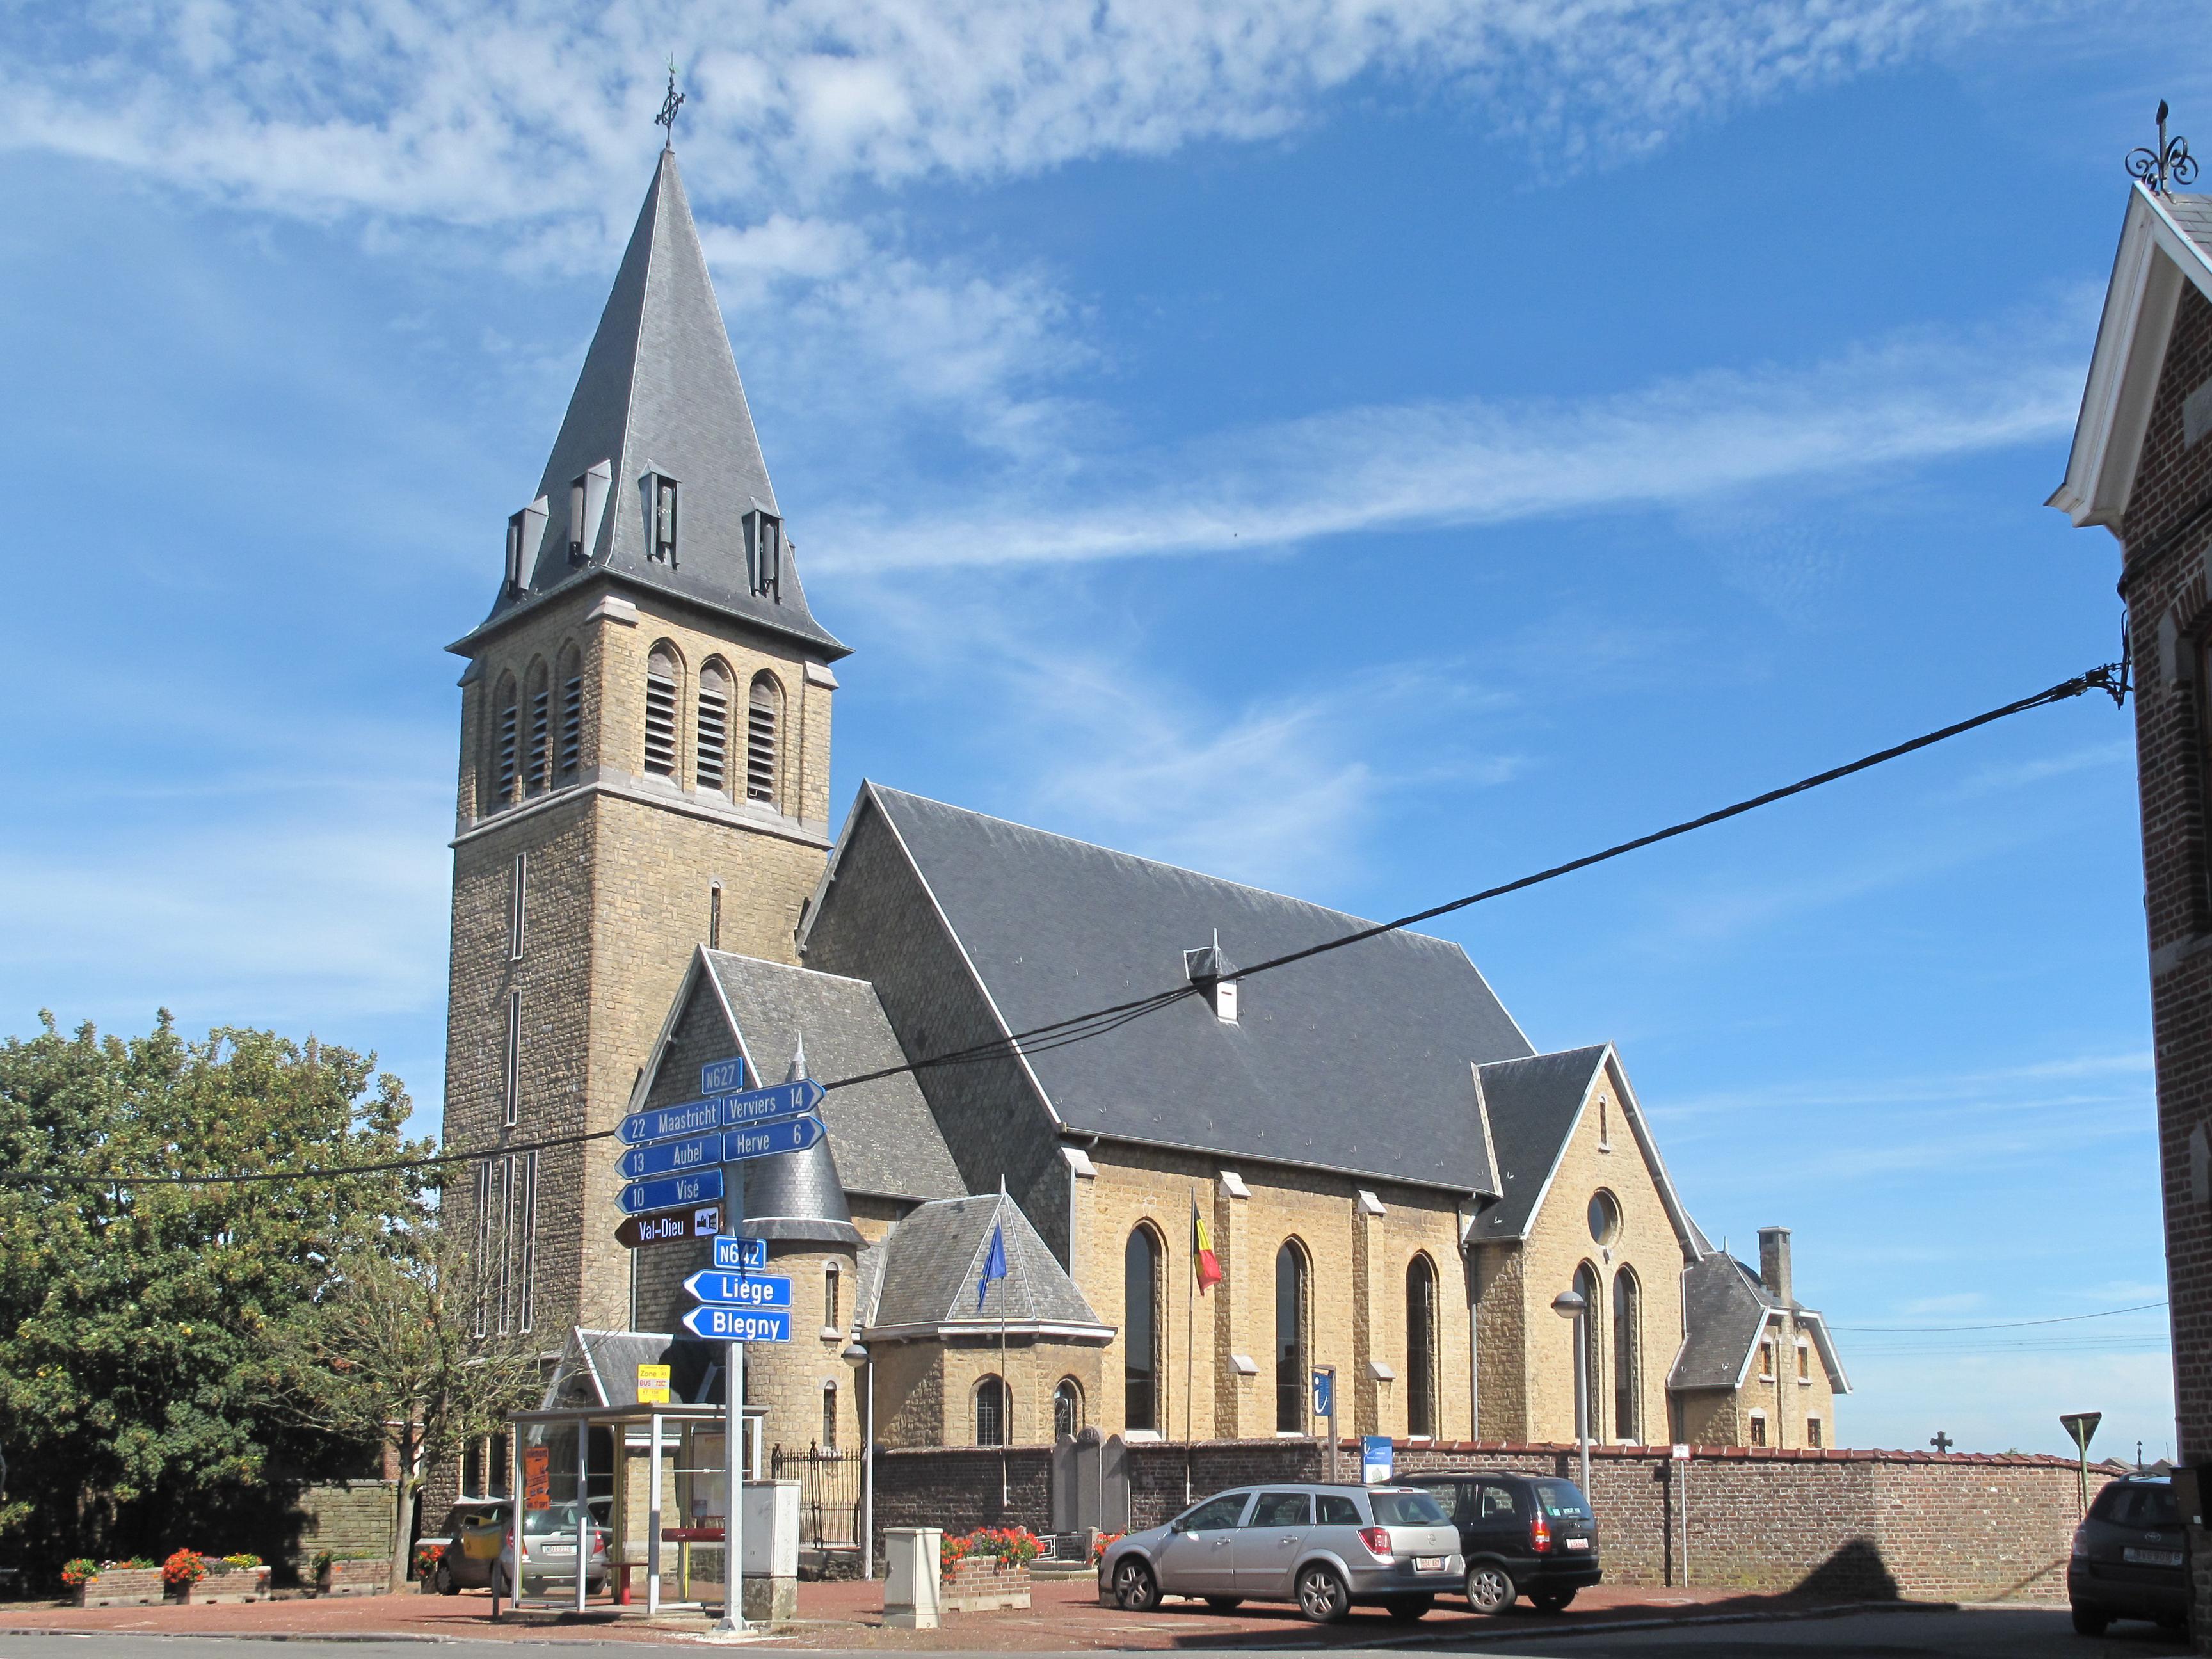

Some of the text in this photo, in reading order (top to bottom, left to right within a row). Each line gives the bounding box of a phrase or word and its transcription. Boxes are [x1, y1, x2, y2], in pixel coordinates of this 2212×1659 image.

[707, 1064, 735, 1089] N627
[730, 1086, 803, 1119] Verviers 14
[632, 1104, 716, 1139] 22 Maastricht
[737, 1123, 801, 1154] Herve 6
[634, 1141, 703, 1173] 13 Aubel
[633, 1178, 699, 1207] 10 Visé
[639, 1218, 684, 1240] Val-Dieu
[720, 1243, 760, 1265] N642
[722, 1276, 774, 1305] Liège
[713, 1311, 780, 1341] Blegny
